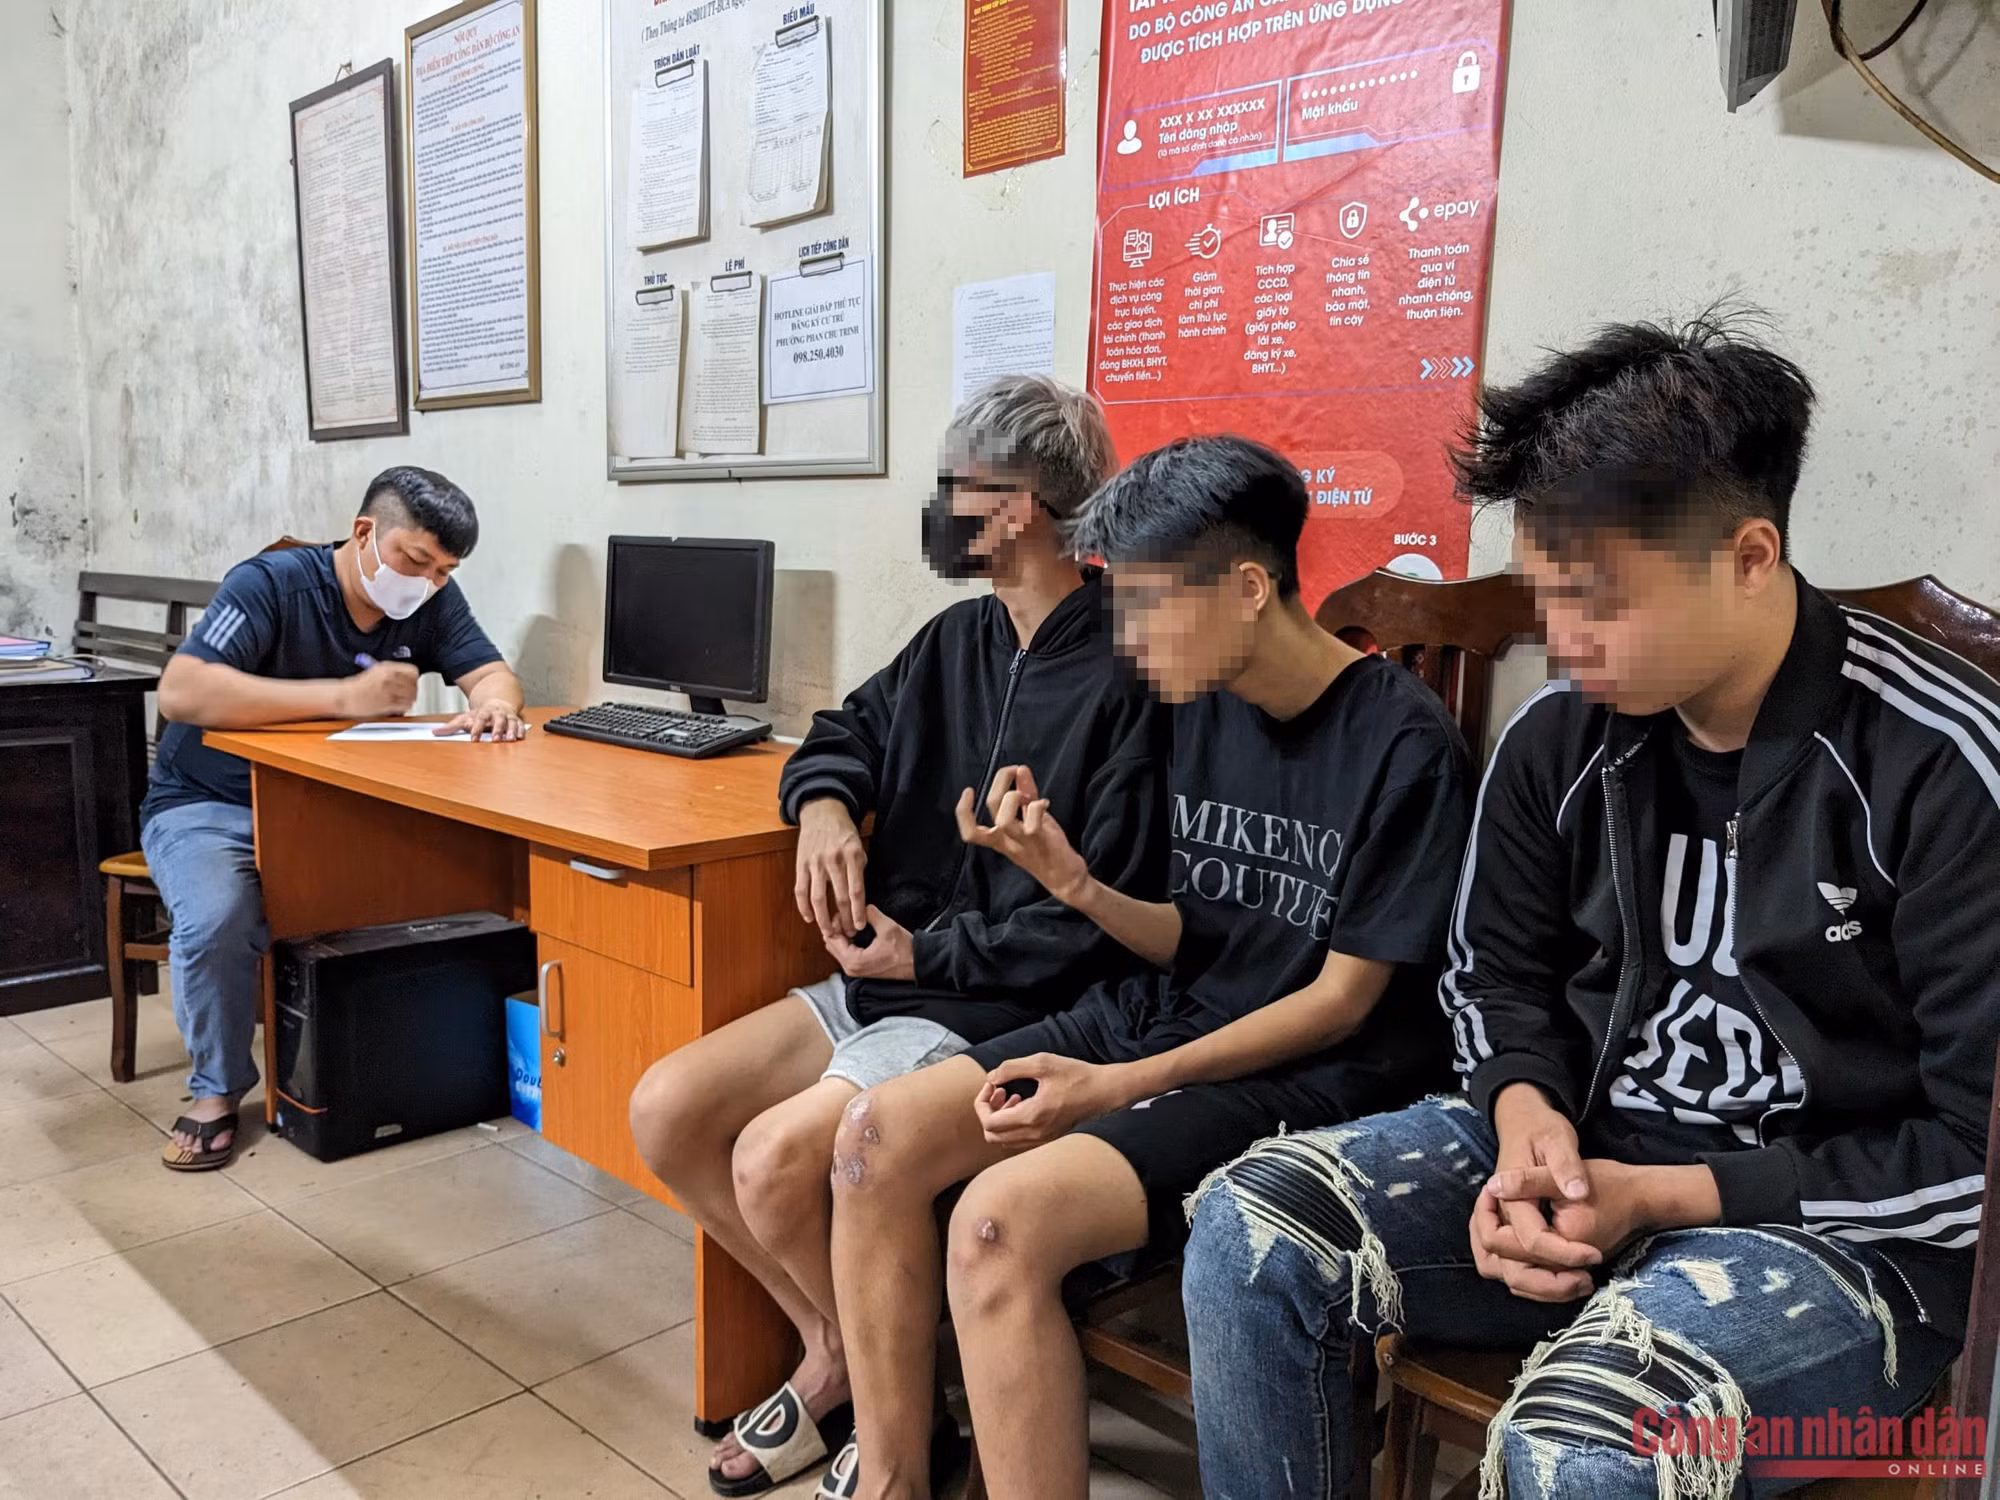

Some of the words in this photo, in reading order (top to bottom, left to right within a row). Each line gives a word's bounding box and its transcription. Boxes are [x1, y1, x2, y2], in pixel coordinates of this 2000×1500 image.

[1129, 21, 1151, 40] DO
[1155, 12, 1176, 34] BỘ
[1180, 2, 1228, 27] CÔNG
[646, 26, 658, 41] Theo
[1140, 39, 1184, 64] ĐƯỢC
[1188, 30, 1223, 52] TÍCH
[1227, 20, 1262, 43] HỢP
[1264, 10, 1304, 34] TRÊN
[1309, 0, 1348, 24] ỨNG
[1302, 104, 1325, 120] Mật
[1328, 98, 1358, 116] khẩu
[1158, 132, 1176, 144] Tên
[1179, 127, 1206, 140] đăng
[1209, 122, 1237, 136] nhập
[1149, 191, 1170, 210] LỢI
[1174, 186, 1200, 205] ÍCH
[1434, 200, 1480, 221] epay
[1408, 246, 1442, 259] Thanh
[1444, 243, 1470, 255] toán
[1332, 256, 1355, 268] Chia
[1420, 262, 1442, 274] qua
[1446, 259, 1455, 270] ví
[1193, 272, 1217, 282] Giảm
[1256, 265, 1274, 276] Tích
[1276, 264, 1295, 275] hợp
[1326, 272, 1355, 284] thông
[1358, 270, 1370, 280] tin
[1109, 282, 1127, 293] Thực
[1129, 280, 1146, 290] hiện
[1148, 278, 1164, 288] các
[1418, 278, 1441, 289] điện
[1445, 274, 1456, 285] tử
[1184, 286, 1201, 297] thời
[1254, 294, 1273, 304] các
[1275, 291, 1293, 302] loại
[1332, 285, 1366, 297] nhanh,
[1110, 295, 1127, 305] dịch
[1140, 292, 1162, 302] công
[1189, 300, 1201, 310] chi
[1204, 298, 1218, 310] phí
[1399, 293, 1433, 305] nhanh
[774, 308, 804, 321] HOTLINE
[848, 296, 861, 309] TỤC
[1256, 307, 1276, 320] giấy
[1279, 306, 1289, 316] tờ
[1325, 301, 1345, 312] bảo
[1406, 309, 1437, 320] thuận
[1440, 306, 1463, 318] tiện.
[1107, 321, 1122, 331] các
[1125, 320, 1142, 331] giao
[1145, 318, 1162, 328] dịch
[1178, 315, 1195, 324] làm
[1197, 312, 1211, 322] thủ
[1213, 312, 1227, 322] tục
[1330, 315, 1341, 326] tin
[1344, 314, 1364, 326] cậy
[1178, 328, 1200, 338] hành
[1202, 326, 1226, 336] chính
[1245, 322, 1269, 335] (giấy
[1271, 320, 1296, 332] phép
[806, 331, 824, 344] PHAN
[839, 326, 859, 338] TRINH
[1115, 332, 1137, 343] chính
[1258, 336, 1269, 345] lái
[793, 345, 844, 364] 098.250.4030
[1106, 347, 1124, 356] toán
[1244, 349, 1268, 362] đăng
[1316, 466, 1336, 484] KÝ
[1316, 488, 1349, 507] ĐIỆN
[1353, 487, 1372, 505] TỬ
[1394, 532, 1426, 545] BƯỚC
[1429, 534, 1437, 546] 3
[1172, 794, 1344, 880] MIKENC
[1171, 849, 1339, 941] COUTUE
